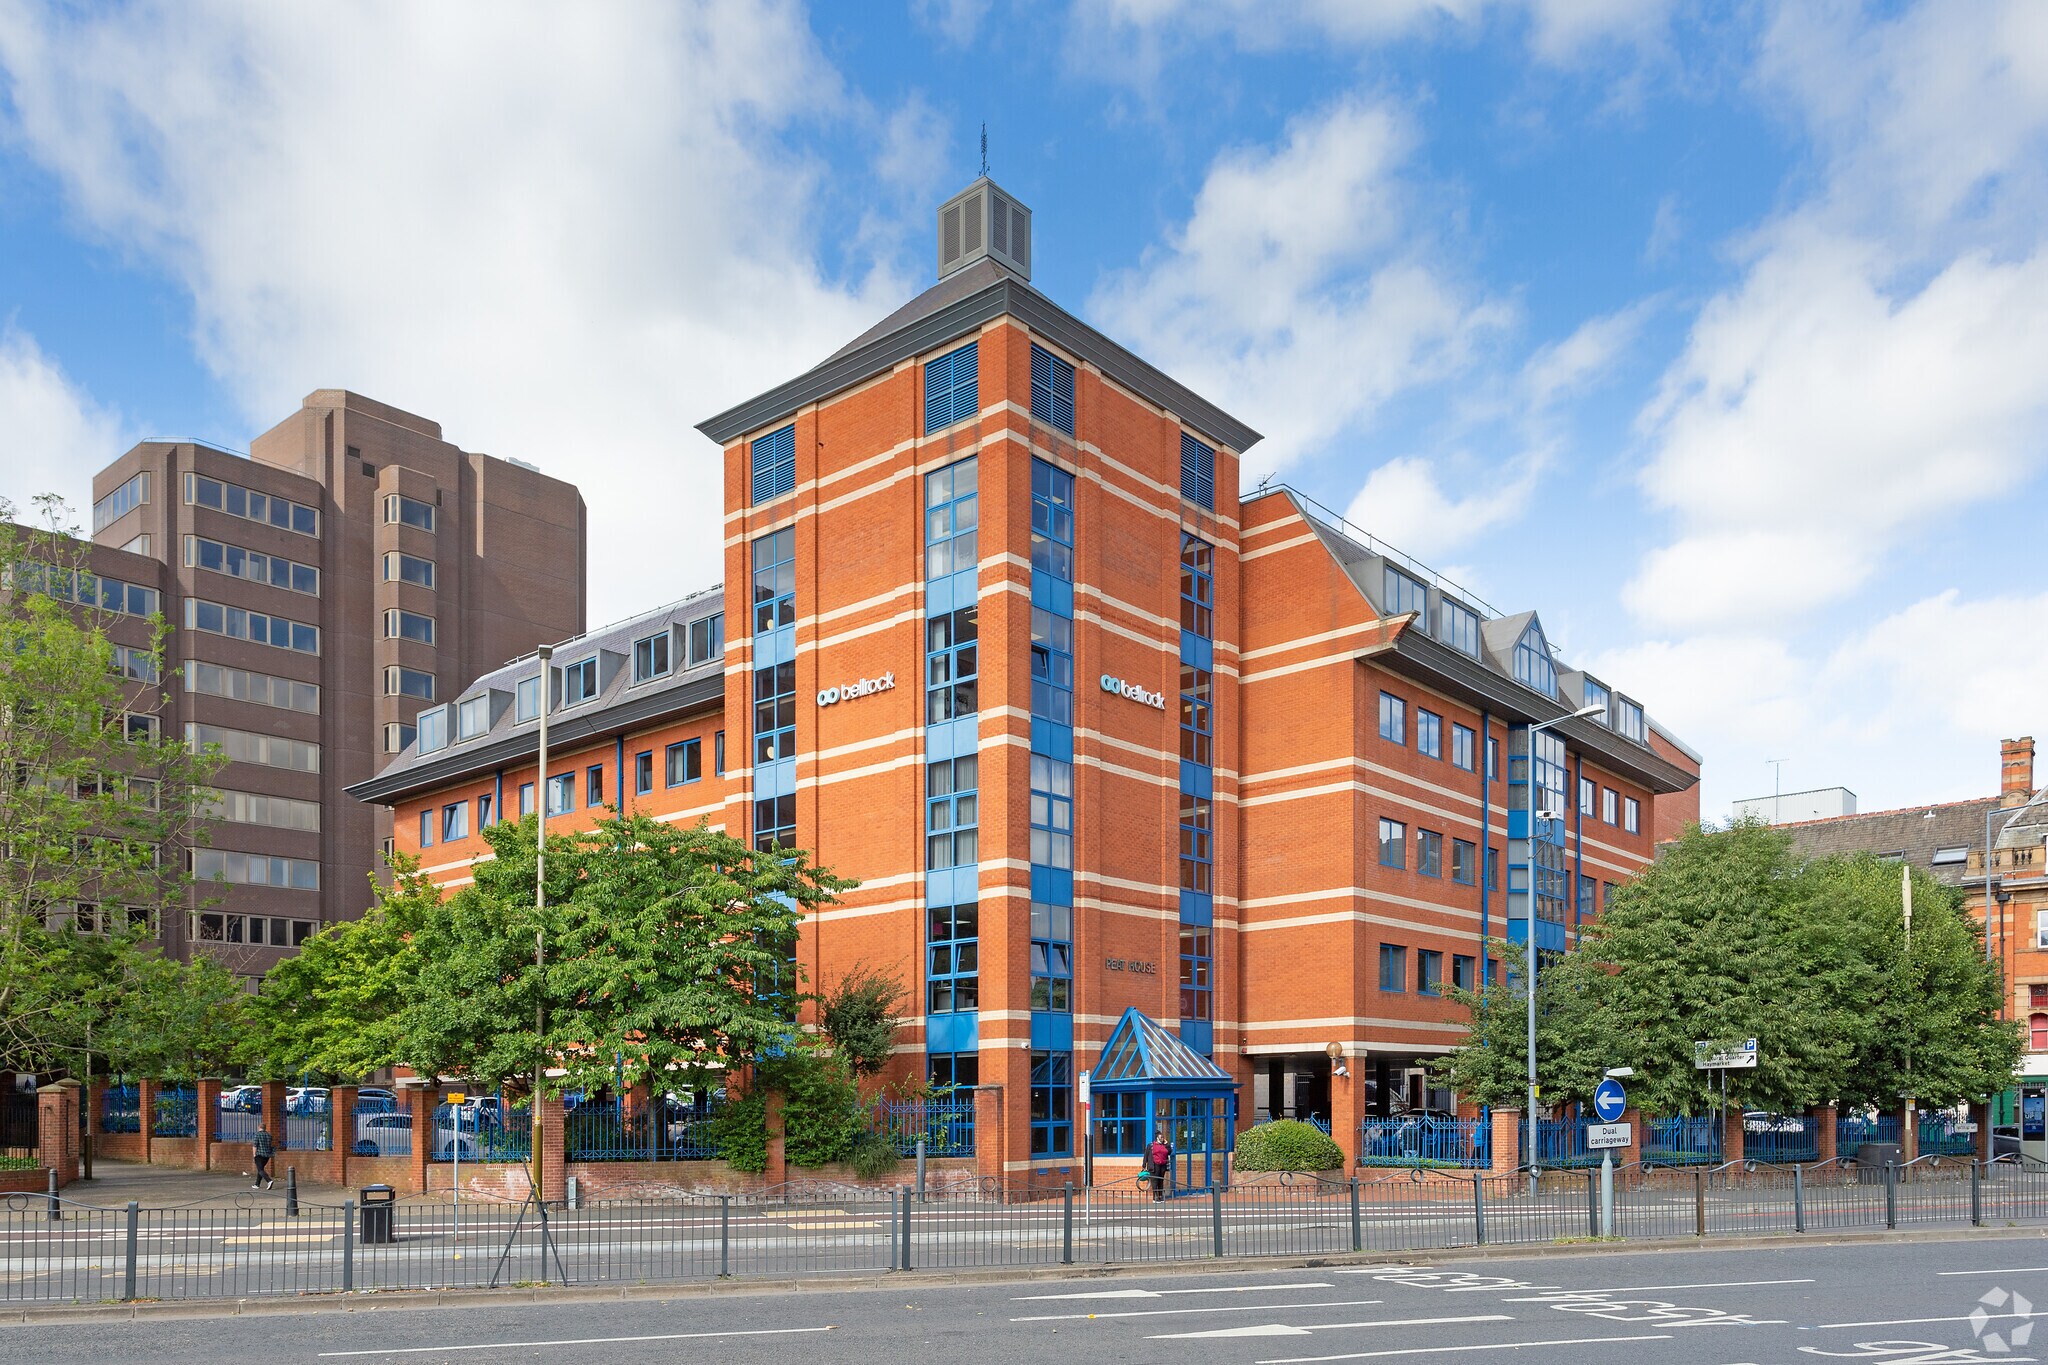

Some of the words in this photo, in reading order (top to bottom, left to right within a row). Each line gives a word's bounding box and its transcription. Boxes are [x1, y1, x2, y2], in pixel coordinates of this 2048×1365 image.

[841, 671, 895, 701] bellrock
[1121, 679, 1165, 710] bellrock
[1105, 957, 1125, 971] PEAT
[1127, 960, 1156, 975] HOUSE
[1590, 1136, 1629, 1145] carriageway
[1602, 1127, 1617, 1135] Dual
[1501, 1293, 1790, 1327] A594
